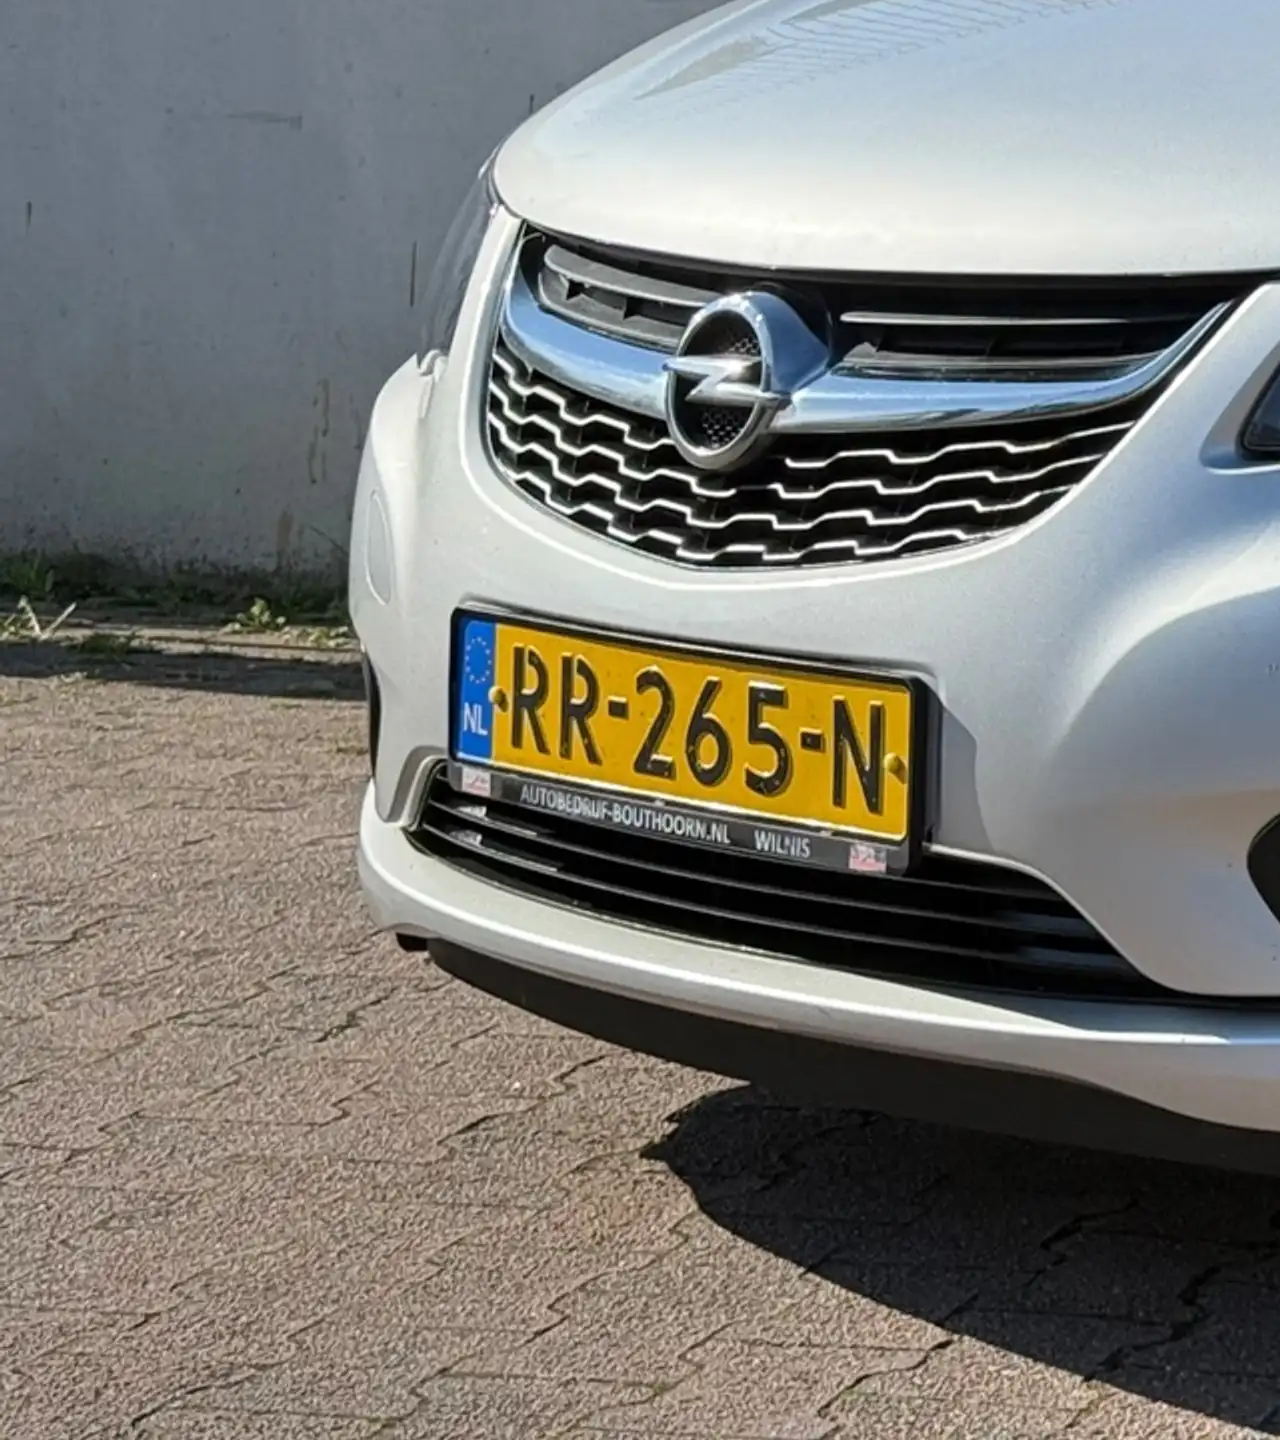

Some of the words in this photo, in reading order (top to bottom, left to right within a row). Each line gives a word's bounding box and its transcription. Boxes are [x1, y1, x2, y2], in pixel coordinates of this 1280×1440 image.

[462, 701, 489, 736] NL
[510, 642, 886, 816] RR-265-N
[753, 828, 812, 859] WILNIS
